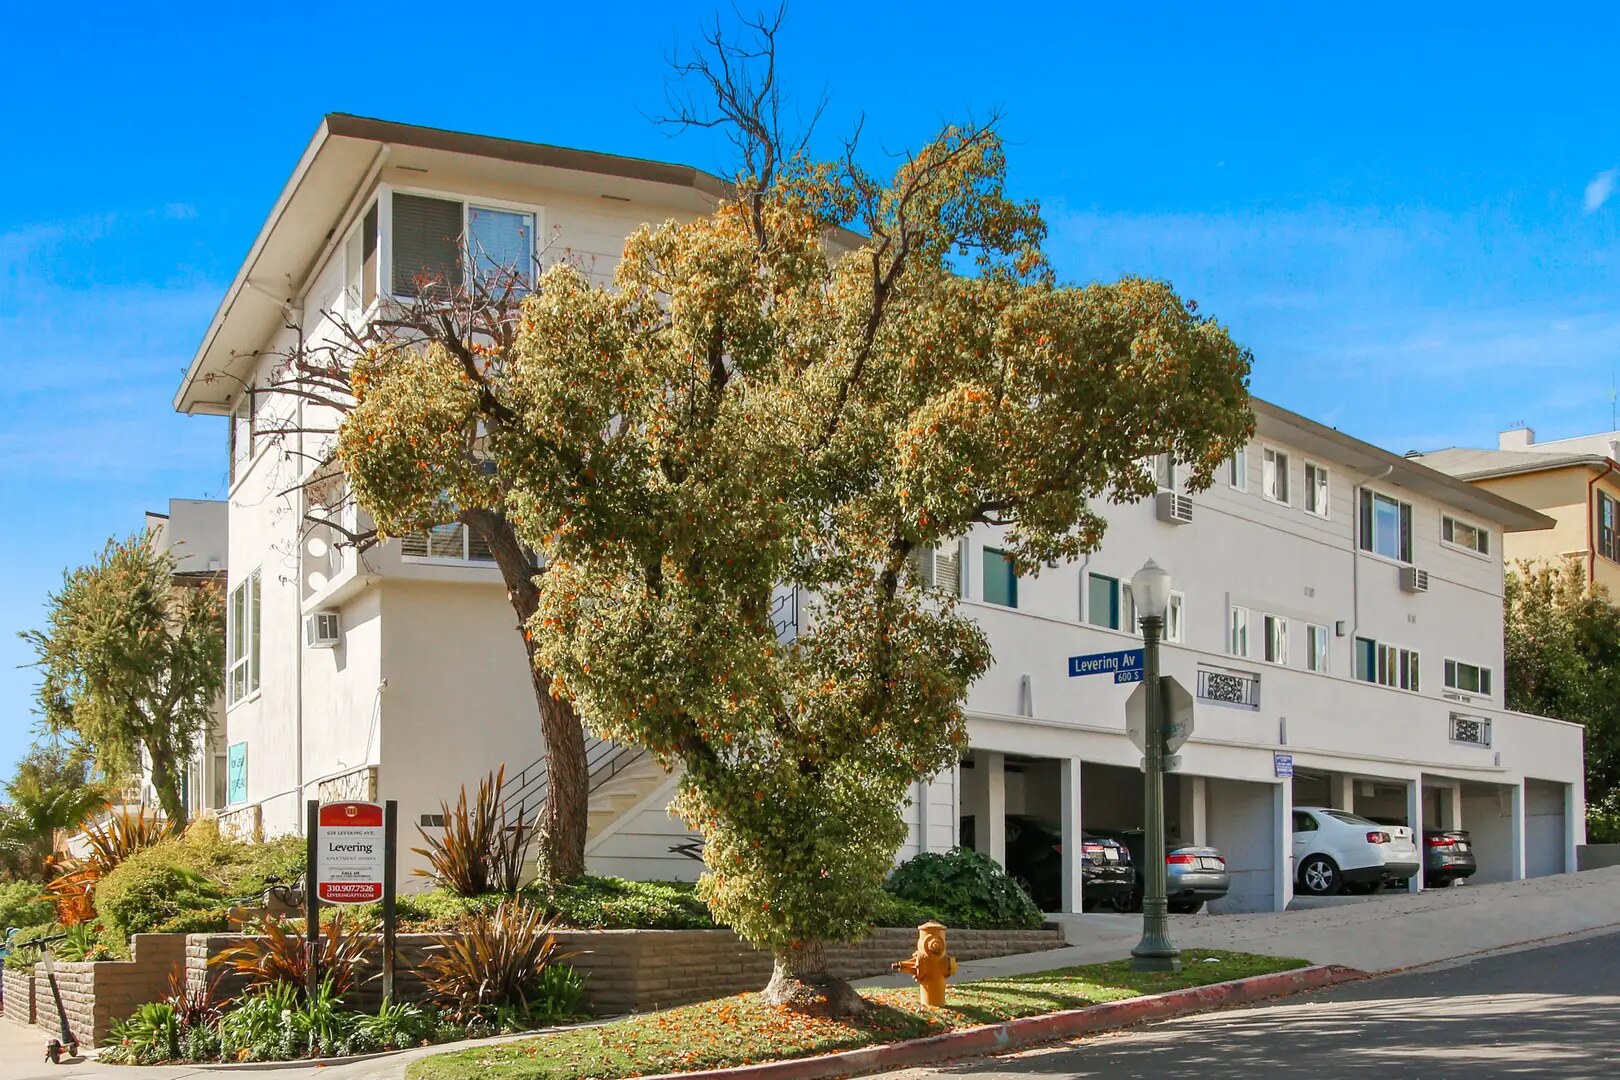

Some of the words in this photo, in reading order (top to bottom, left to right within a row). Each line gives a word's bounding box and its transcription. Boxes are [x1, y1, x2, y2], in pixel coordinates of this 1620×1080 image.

[1075, 656, 1119, 672] Levering
[1122, 653, 1136, 667] Av
[1118, 672, 1132, 682] 600
[1134, 671, 1139, 680] S
[329, 842, 373, 854] Levering
